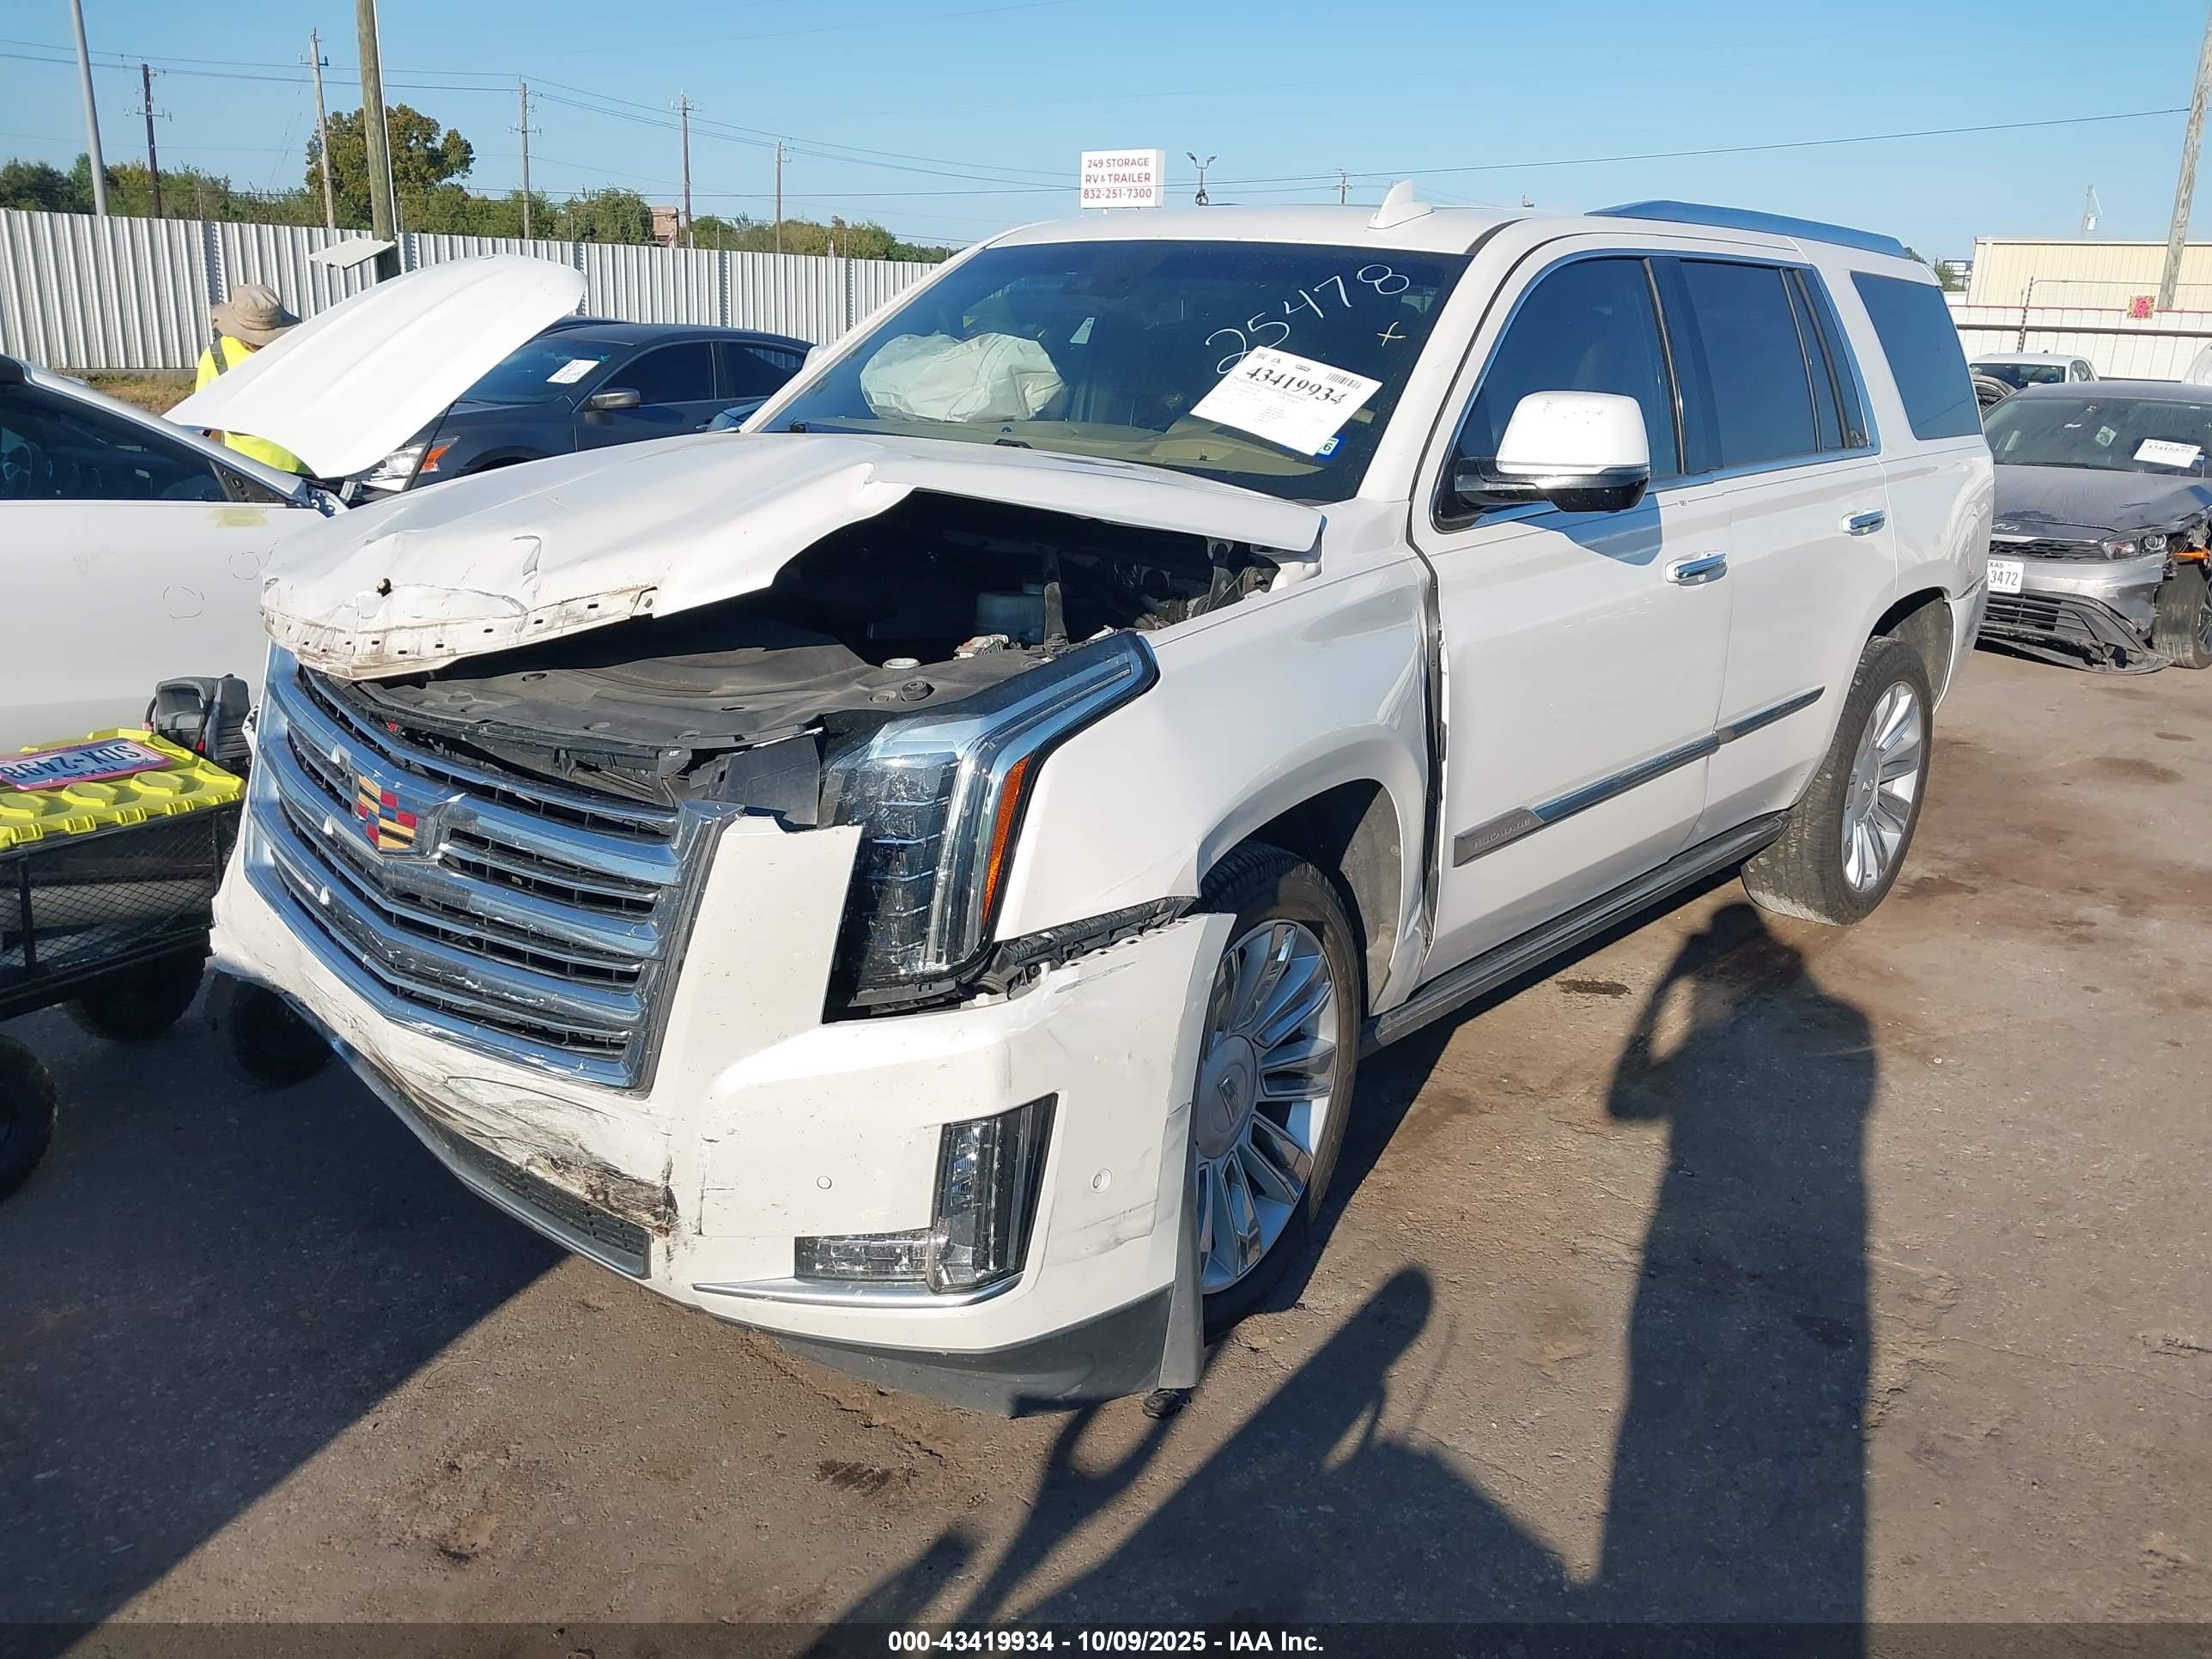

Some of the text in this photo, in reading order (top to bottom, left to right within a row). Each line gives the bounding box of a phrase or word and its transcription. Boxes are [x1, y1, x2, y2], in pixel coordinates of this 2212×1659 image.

[1087, 157, 1150, 168] 249 STORAGE
[1085, 174, 1099, 184] RV
[1107, 173, 1151, 183] TRAILER
[1084, 188, 1152, 199] 832-251-7300
[1205, 264, 1410, 374] 25478
[1245, 366, 1348, 405] 43419934
[1990, 569, 2018, 586] 3472
[63, 765, 118, 779] TEXAS
